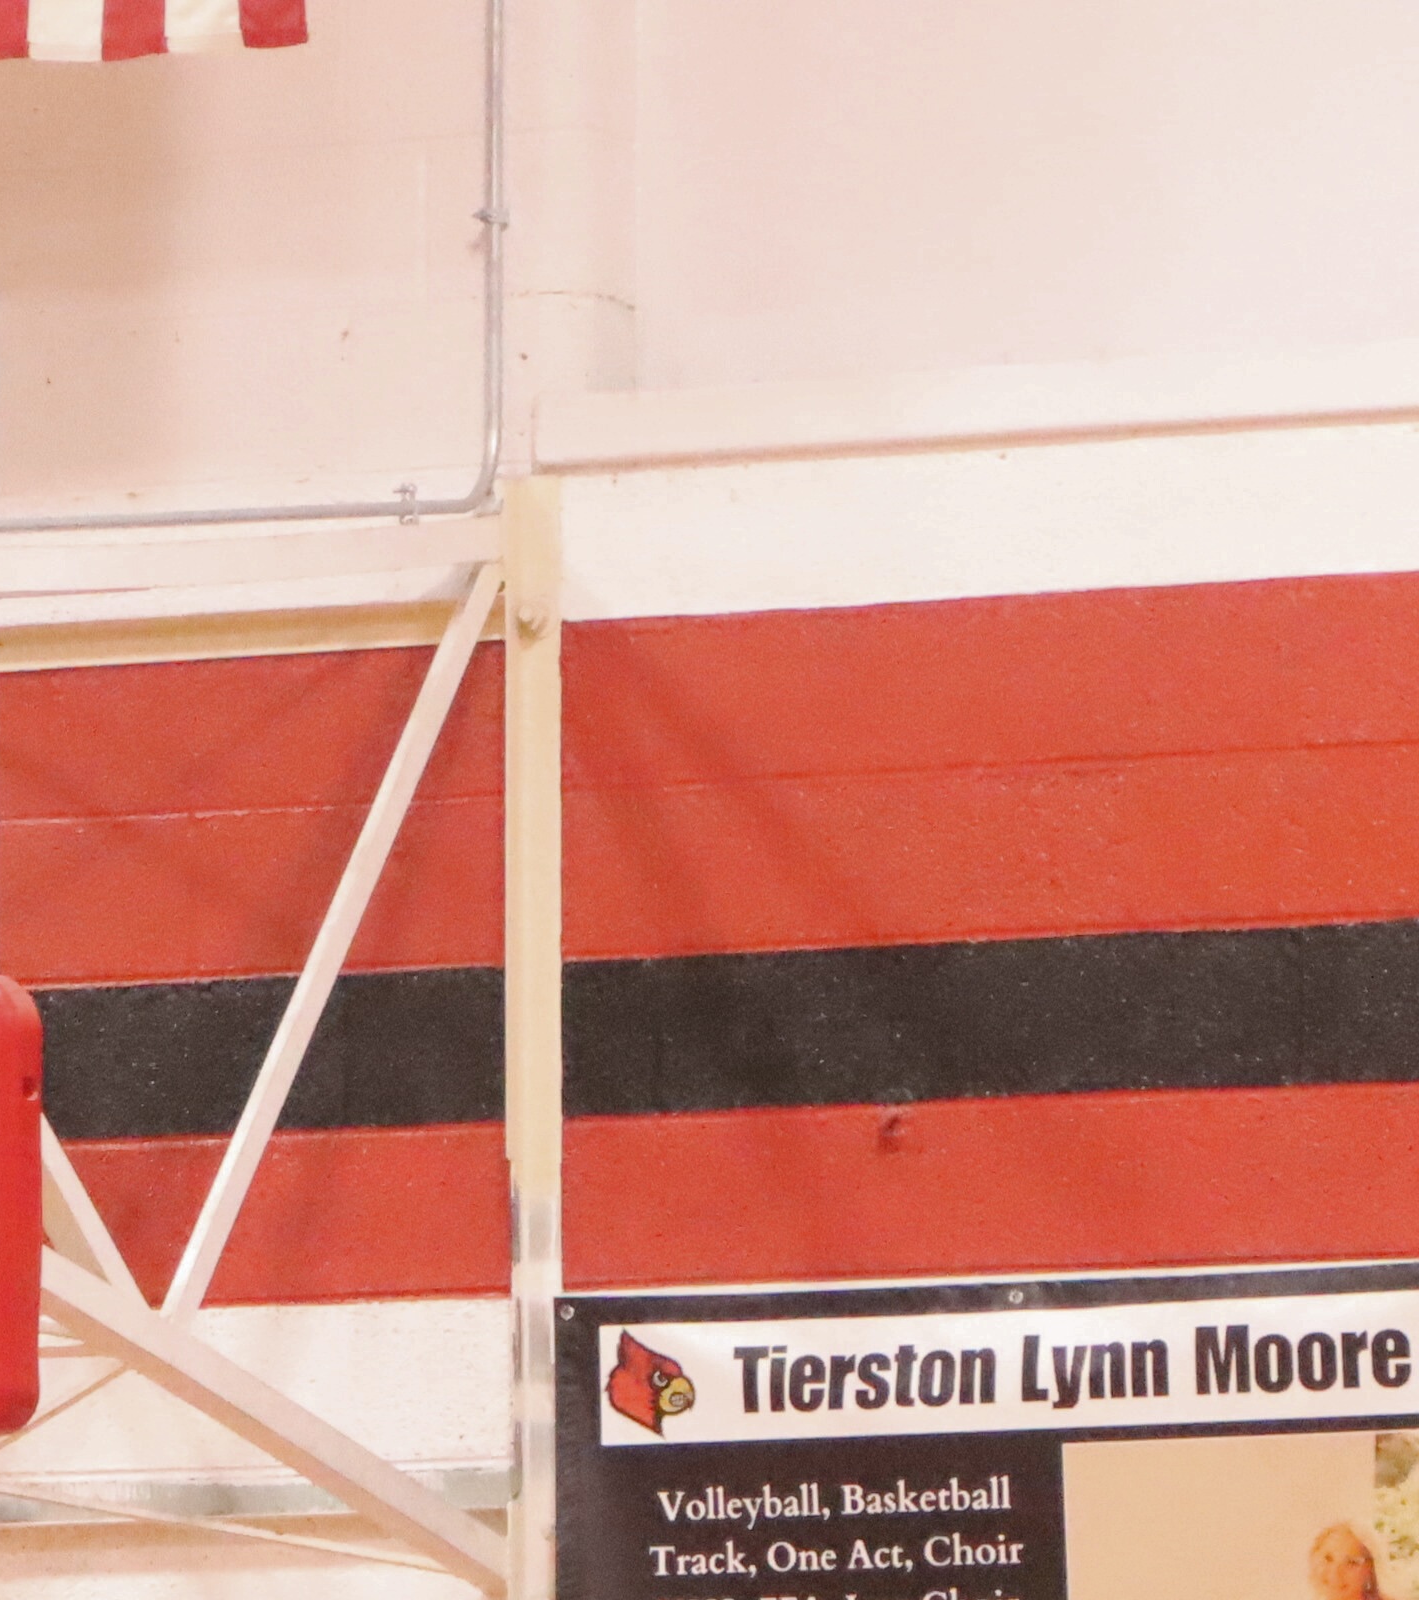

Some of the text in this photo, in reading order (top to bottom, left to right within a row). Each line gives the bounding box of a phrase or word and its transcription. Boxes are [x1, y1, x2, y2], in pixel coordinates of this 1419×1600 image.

[734, 1325, 1411, 1413] Tierston Lynn Moore
[658, 1476, 1011, 1529] Volleyball, Basketball
[649, 1533, 1023, 1577] Track, One Act, Choir
